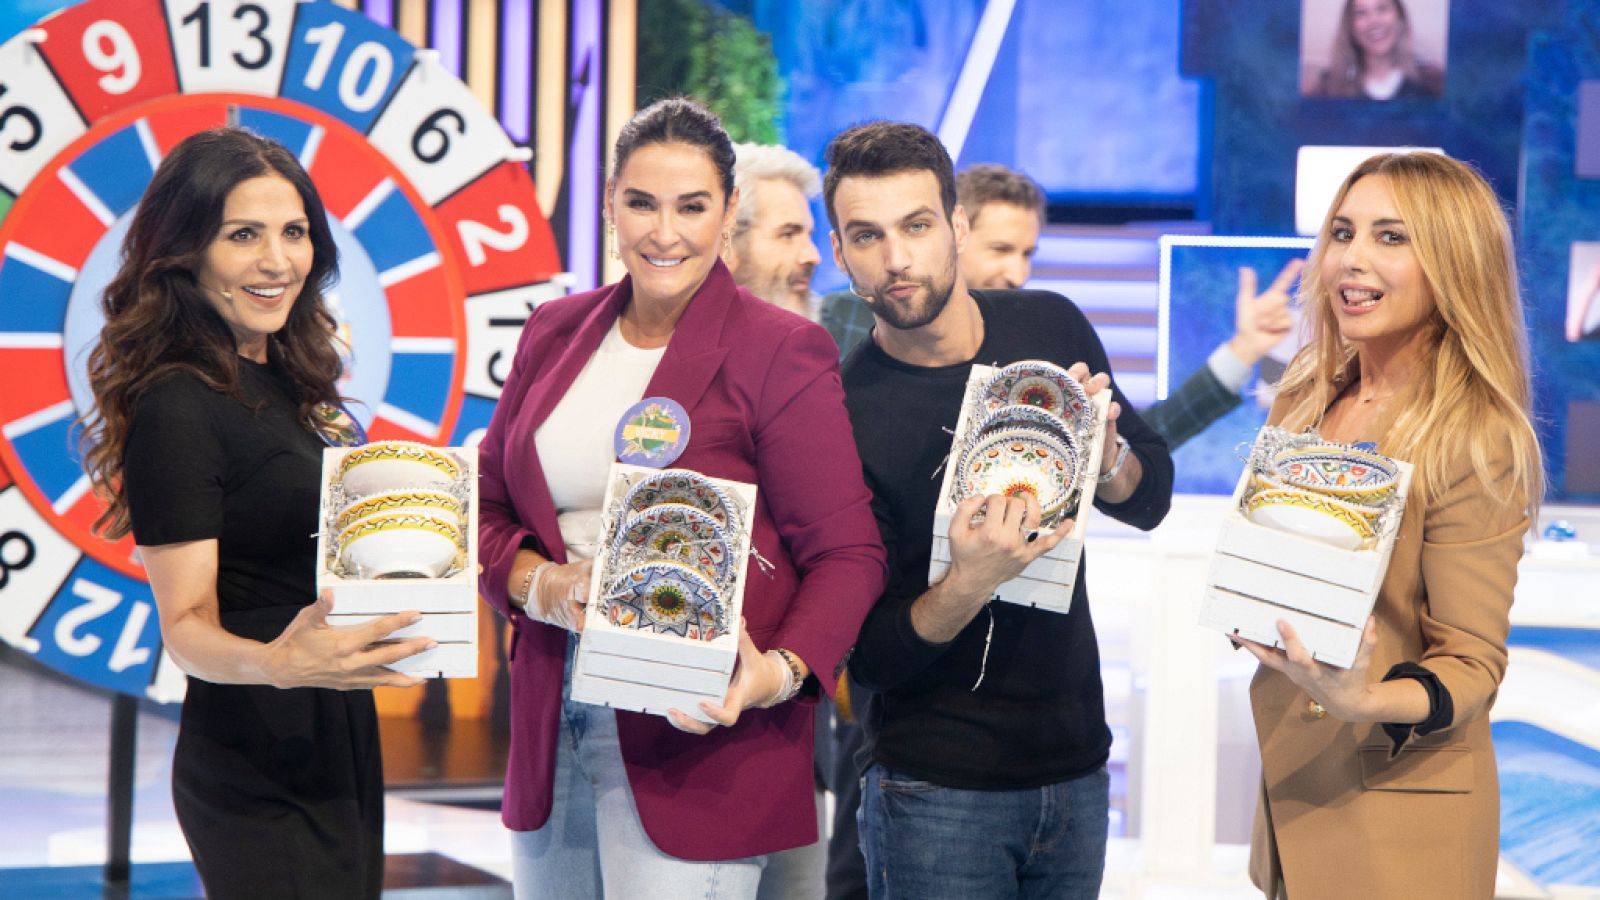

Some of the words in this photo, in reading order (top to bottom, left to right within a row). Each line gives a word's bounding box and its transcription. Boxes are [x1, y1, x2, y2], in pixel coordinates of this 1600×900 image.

[82, 19, 141, 95] 9
[181, 1, 273, 69] 13
[303, 21, 394, 112] 10
[411, 107, 466, 164] 6
[456, 204, 530, 267] 2
[54, 577, 152, 673] 12
